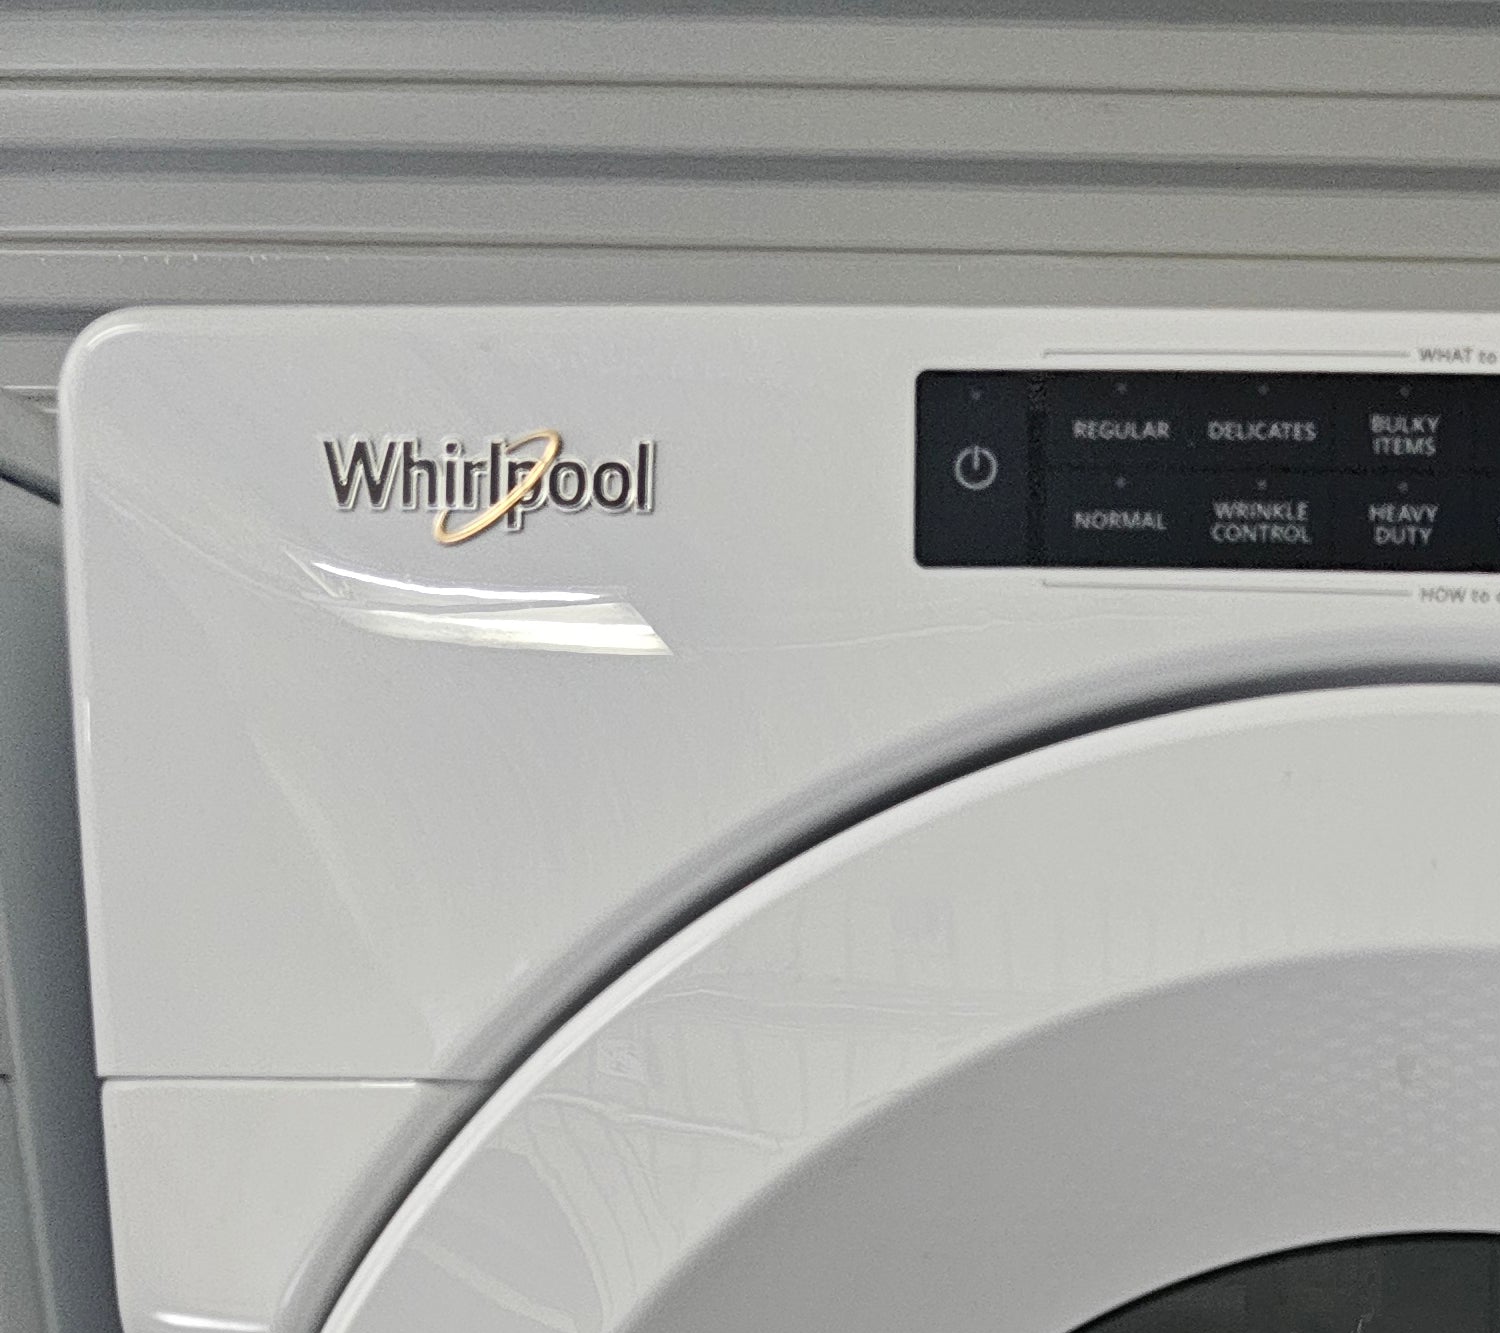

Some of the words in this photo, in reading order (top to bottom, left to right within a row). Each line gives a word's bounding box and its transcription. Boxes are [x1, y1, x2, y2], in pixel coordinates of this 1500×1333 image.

[1419, 348, 1472, 363] WHAT
[1479, 351, 1497, 365] to
[1072, 419, 1171, 442] REGULAR
[1207, 420, 1316, 443] DELICATES
[1370, 414, 1440, 435] BULKY
[1372, 436, 1436, 457] ITEMS
[322, 432, 656, 534] Whirlpool
[1073, 511, 1168, 532] NORMAL
[1211, 501, 1309, 522] WRINKLE
[1369, 504, 1438, 524] HEAVY
[1210, 523, 1312, 545] CONTROL
[1374, 524, 1433, 546] DUTY
[1420, 587, 1466, 603] HOW
[1471, 589, 1490, 603] to
